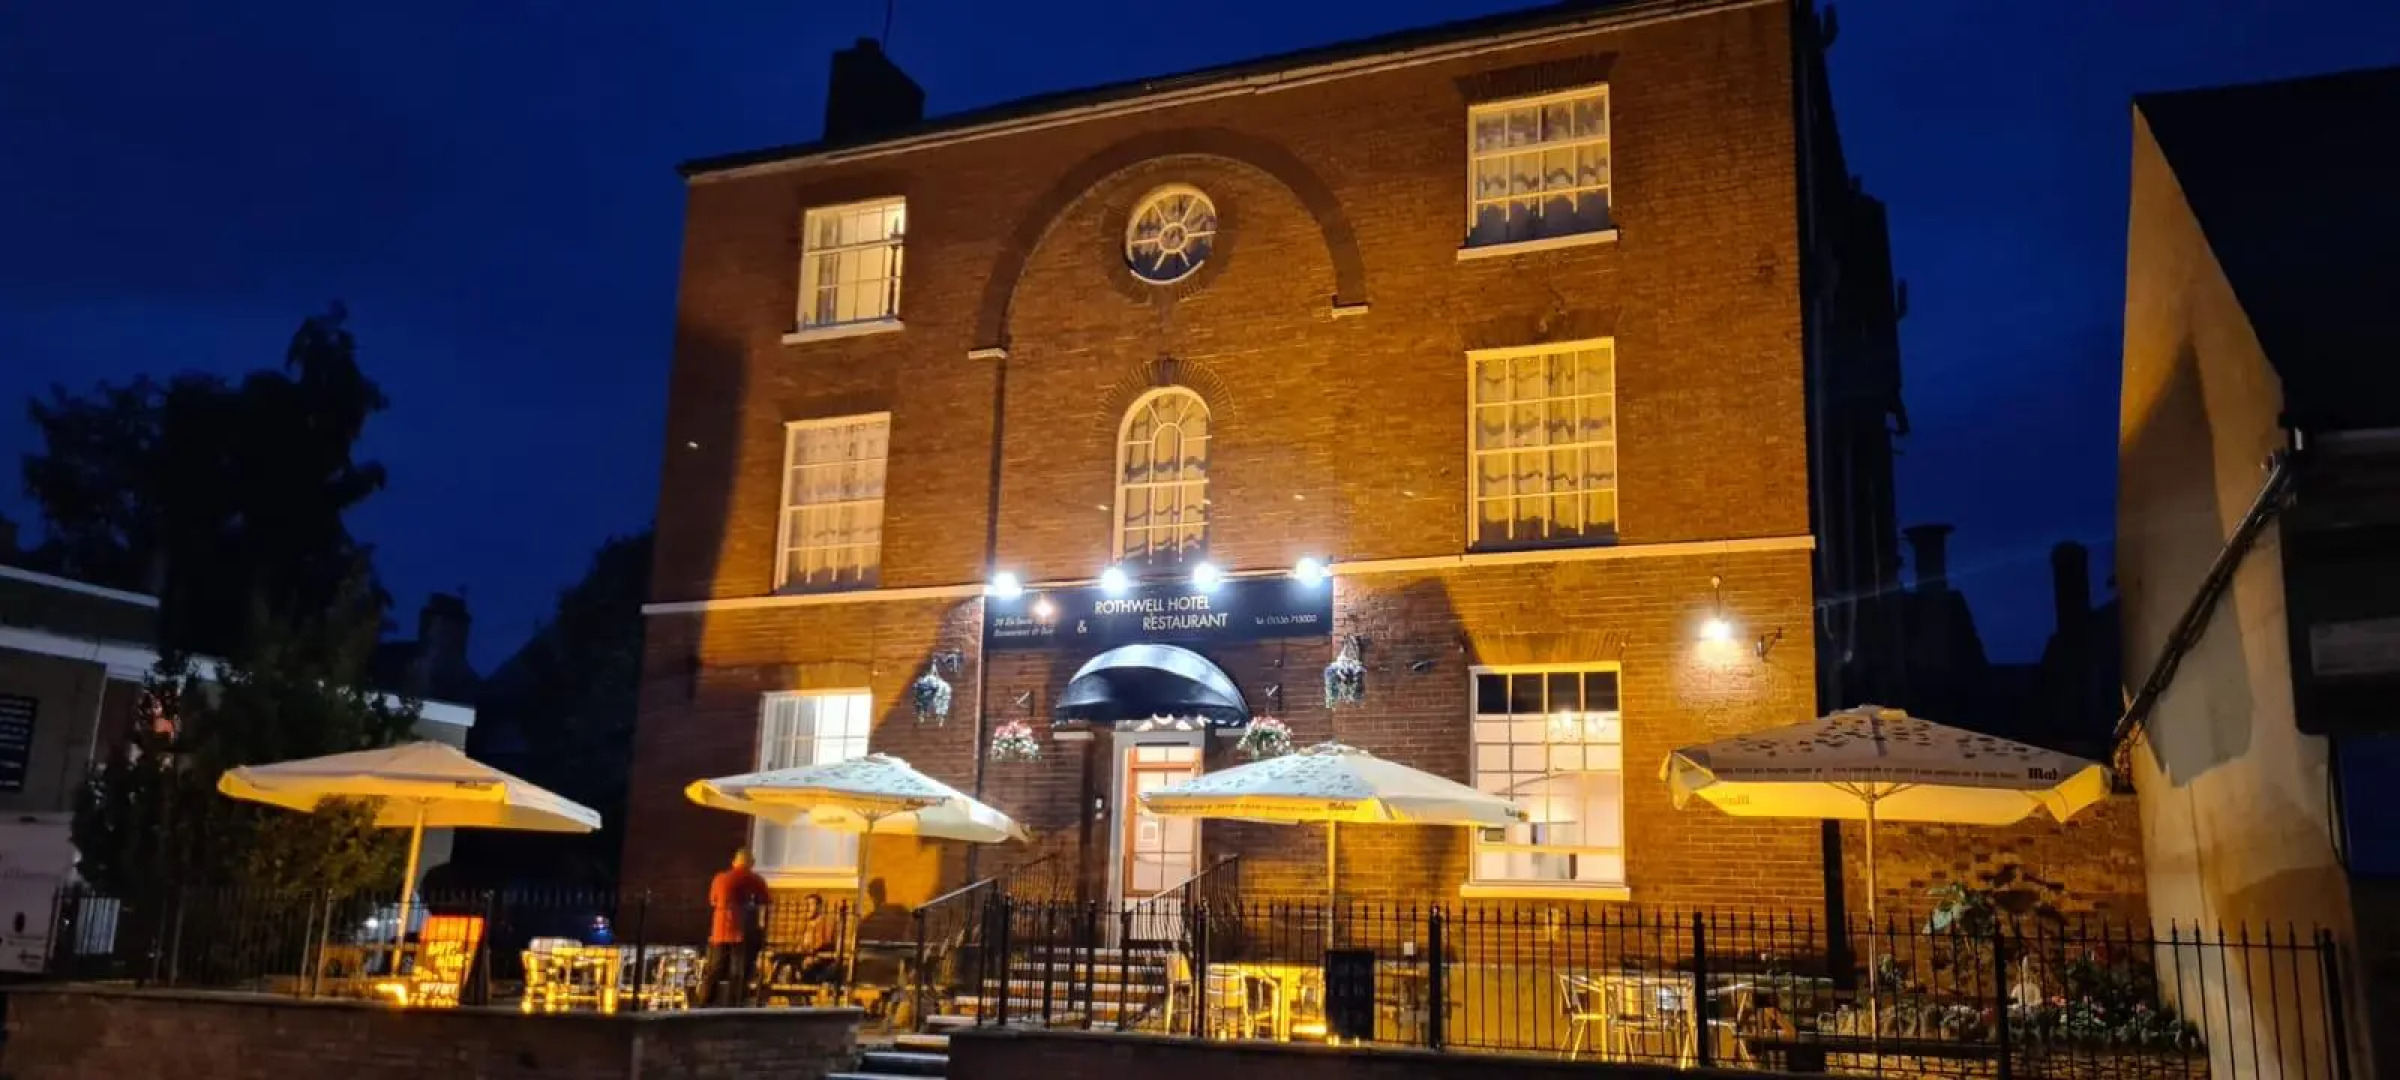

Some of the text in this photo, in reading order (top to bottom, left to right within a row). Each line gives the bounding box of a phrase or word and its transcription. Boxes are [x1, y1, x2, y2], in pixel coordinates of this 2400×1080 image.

[1094, 595, 1210, 615] ROTHWELL HOTEL
[1076, 612, 1228, 634] & RESTAURANT
